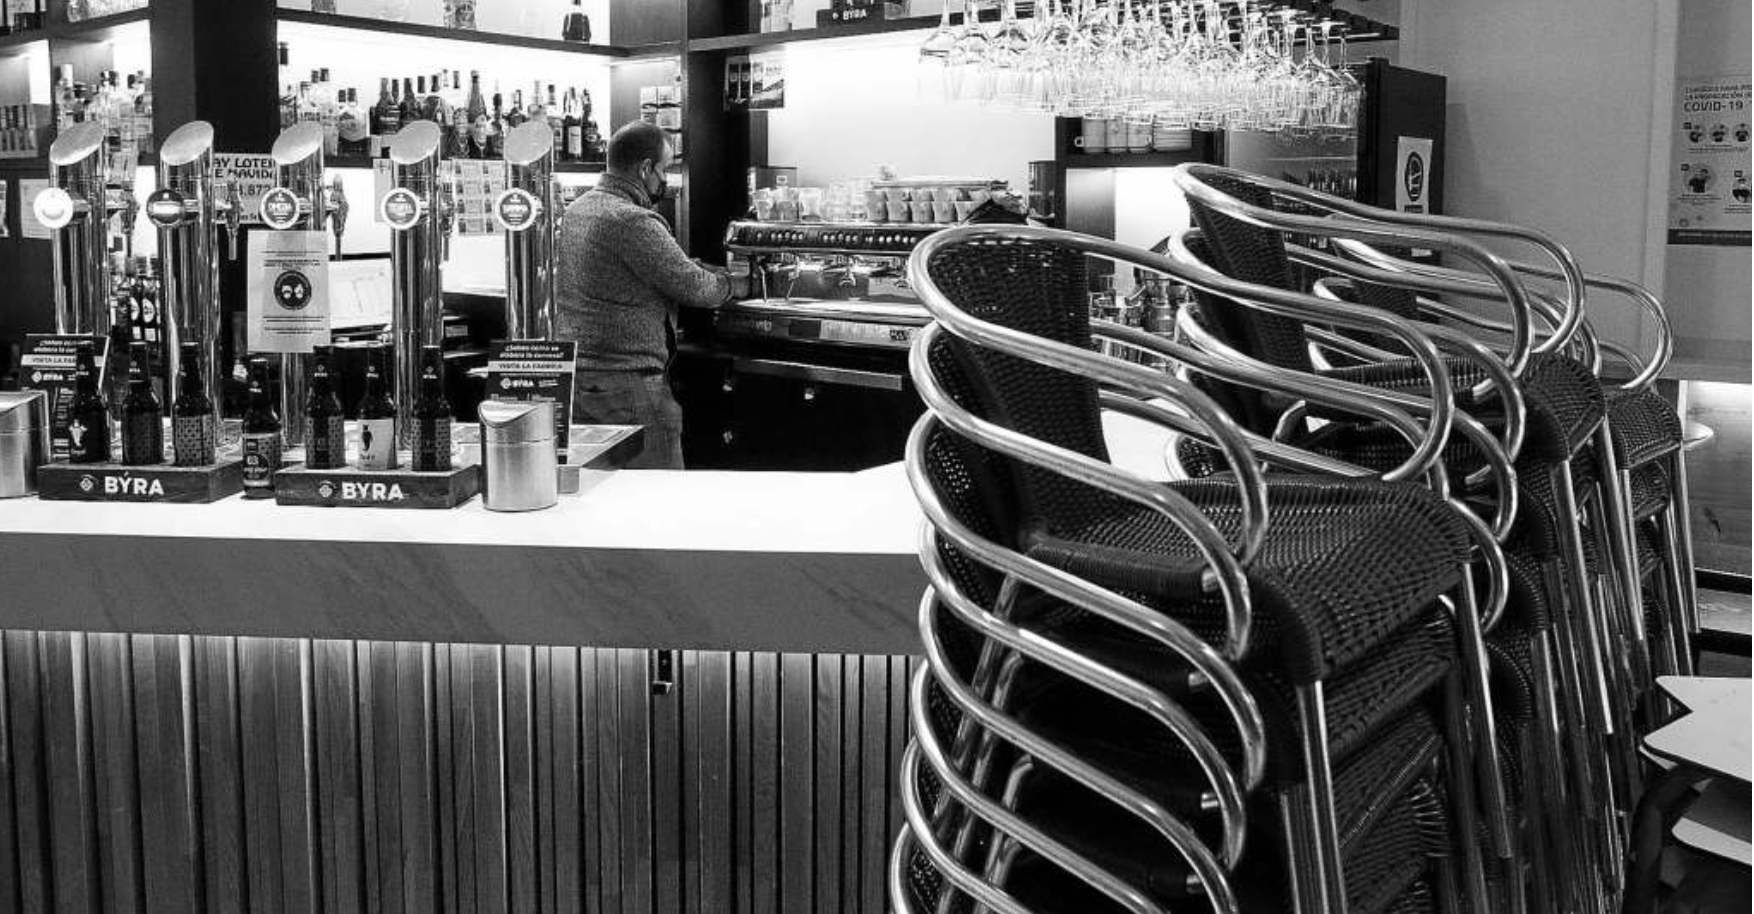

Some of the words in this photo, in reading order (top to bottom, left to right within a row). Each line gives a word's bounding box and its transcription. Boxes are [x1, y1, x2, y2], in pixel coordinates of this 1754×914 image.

[1684, 101, 1743, 112] COVID-19
[213, 158, 230, 168] AY
[214, 168, 224, 178] E
[341, 481, 405, 501] BYRA
